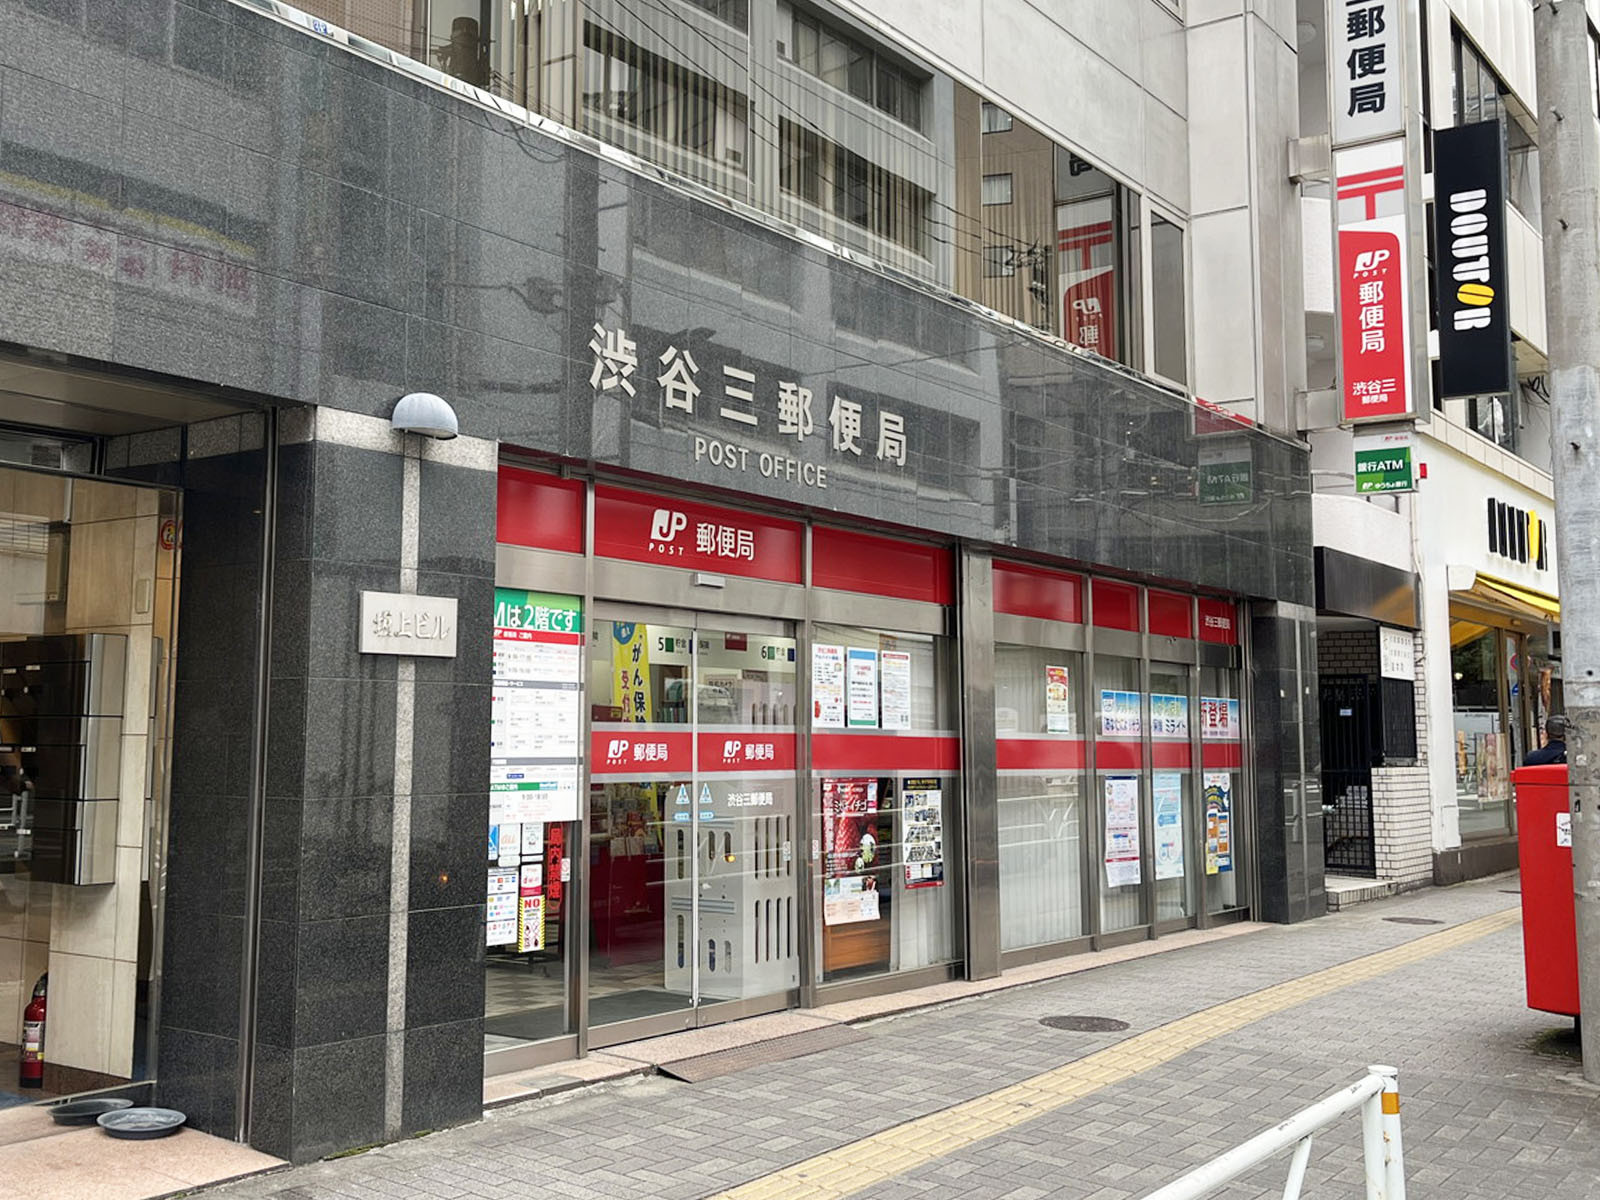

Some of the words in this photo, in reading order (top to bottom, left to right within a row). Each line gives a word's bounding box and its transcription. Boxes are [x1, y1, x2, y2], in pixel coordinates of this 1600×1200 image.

[1345, 0, 1387, 117] 郵便局
[1354, 249, 1390, 272] JP
[1450, 189, 1495, 331] DOUTOR
[1353, 268, 1388, 279] POST
[1359, 281, 1385, 354] 郵便局
[589, 322, 908, 467] 渋谷三郵便局
[1353, 378, 1397, 395] 渋谷三
[1361, 393, 1389, 404] 郵便局
[695, 437, 749, 471] POST
[759, 454, 827, 488] OFFICE
[1357, 459, 1404, 473] 銀行ATM
[650, 508, 688, 542] JP
[649, 542, 685, 556] POST
[696, 522, 755, 561] 郵便局
[658, 637, 665, 652] 5
[761, 646, 767, 659] 6
[633, 743, 668, 761] 郵便局
[745, 744, 774, 761] 郵便局
[727, 791, 774, 807] 渋谷三郵便局
[524, 898, 540, 909] NO
